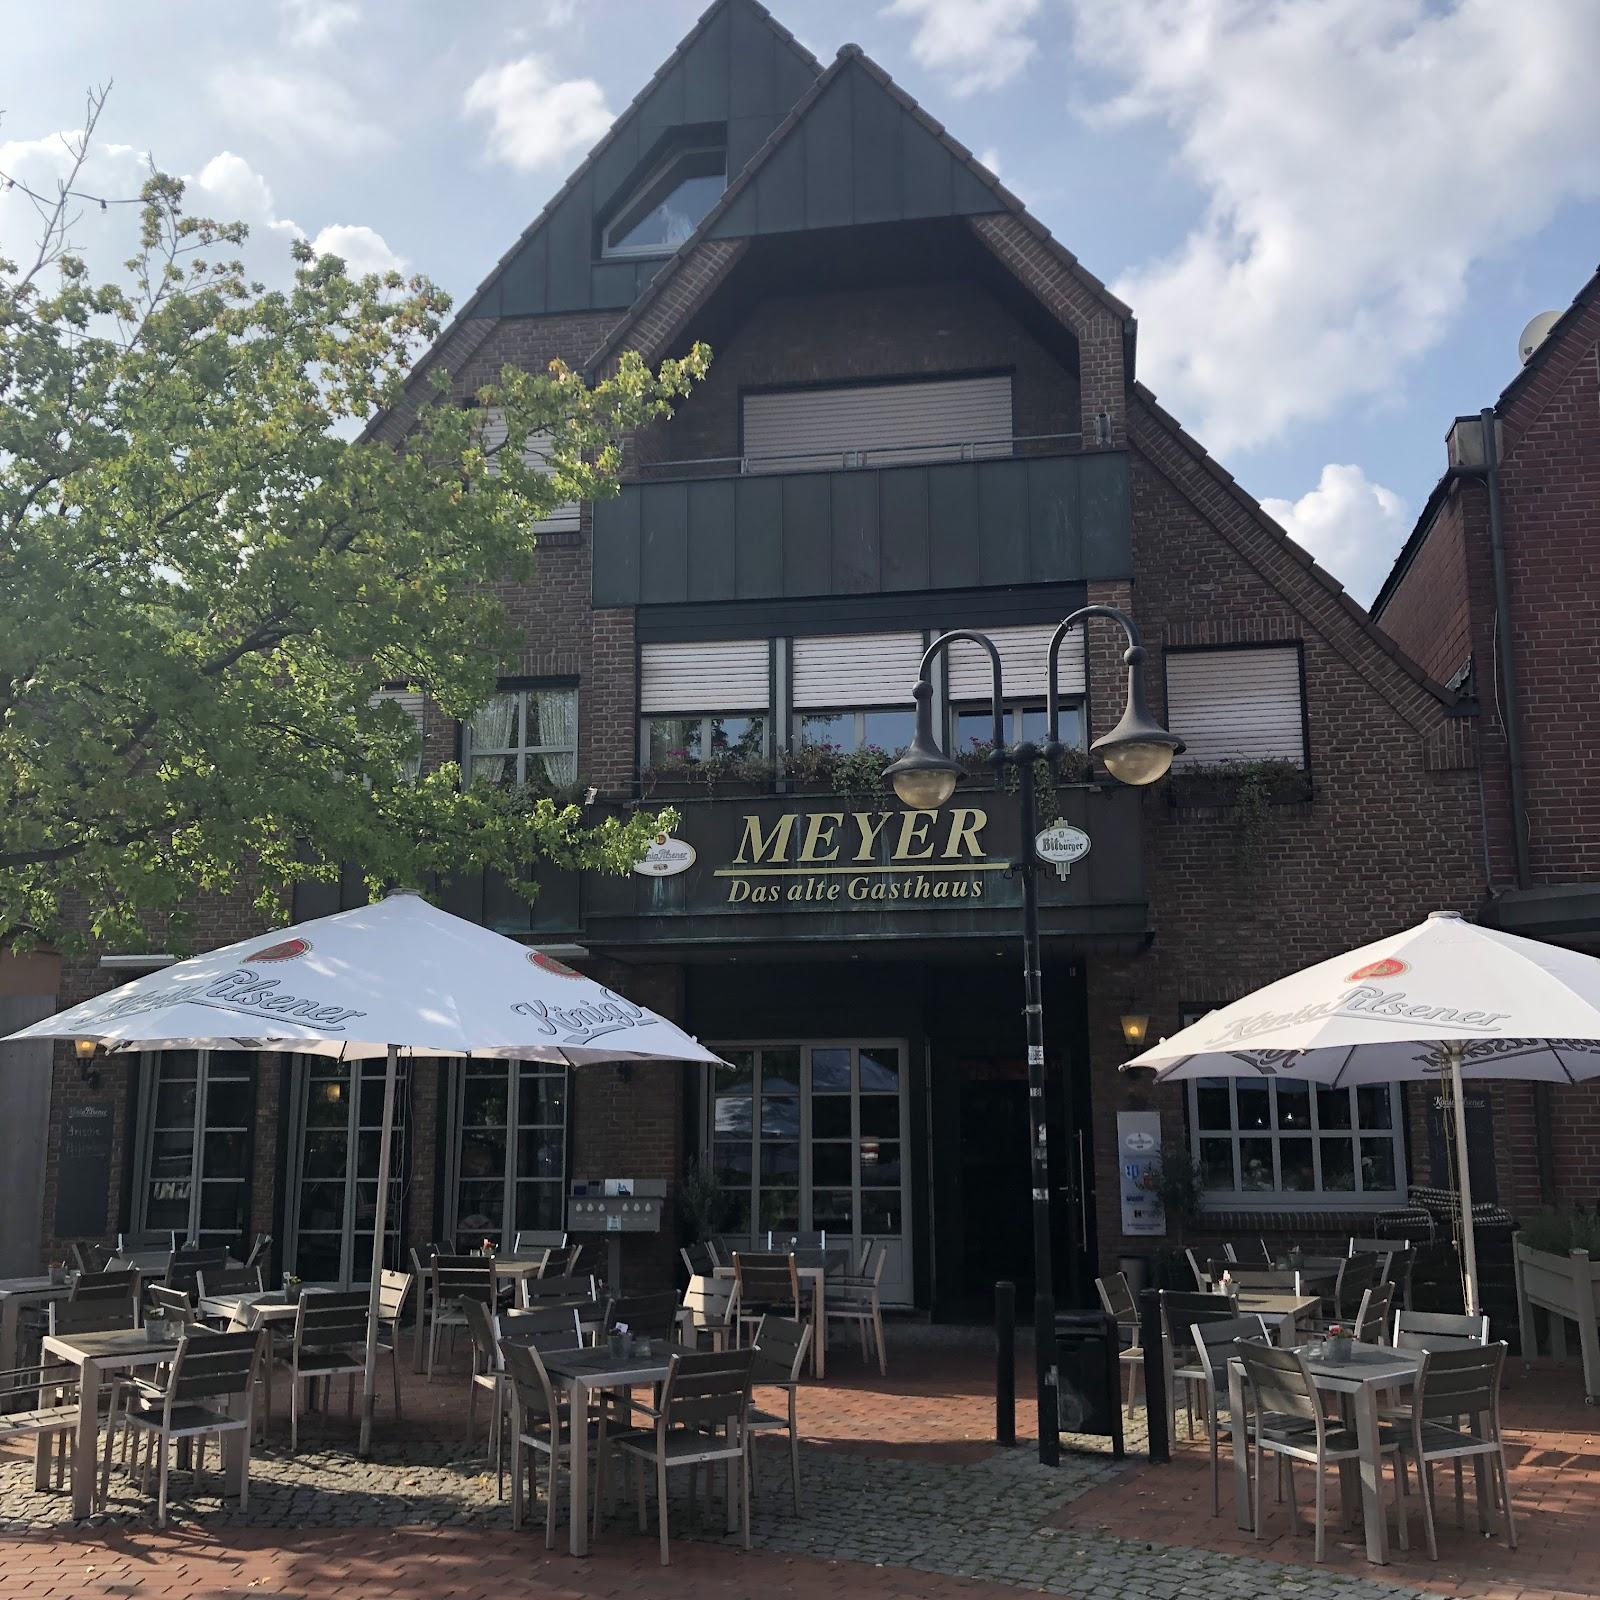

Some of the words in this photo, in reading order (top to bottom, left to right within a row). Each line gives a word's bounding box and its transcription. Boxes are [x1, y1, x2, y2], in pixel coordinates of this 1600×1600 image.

[659, 848, 688, 860] Pilsener
[732, 808, 988, 864] MEYER
[1042, 837, 1083, 852] Bitburger
[727, 879, 781, 903] Das
[787, 877, 840, 901] alte
[847, 874, 983, 901] Gasthaus
[205, 969, 368, 1025] Pilsener
[1336, 985, 1512, 1027] Pilsener
[510, 999, 636, 1036] König
